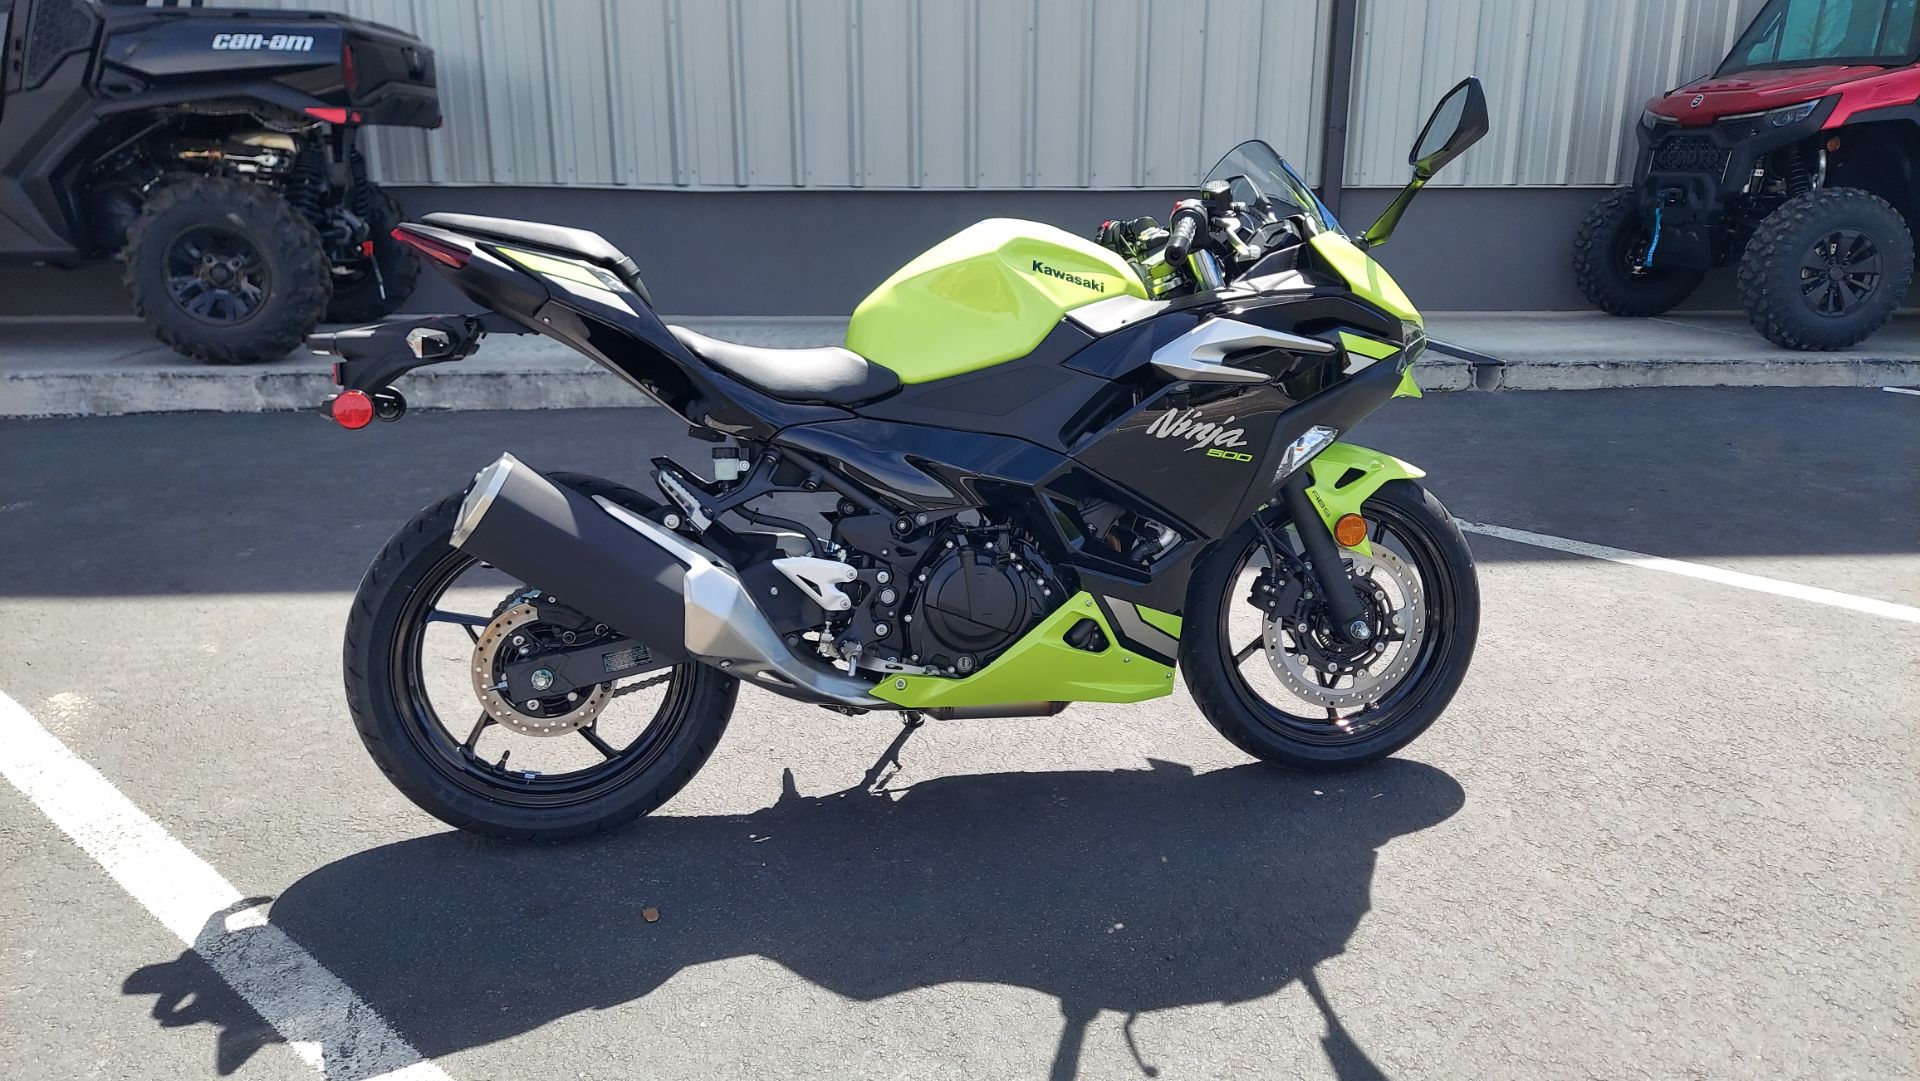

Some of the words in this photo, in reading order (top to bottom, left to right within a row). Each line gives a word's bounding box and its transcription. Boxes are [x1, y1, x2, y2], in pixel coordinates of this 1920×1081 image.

[212, 34, 314, 51] can-am
[1032, 260, 1105, 293] Kawasaki
[1146, 407, 1247, 452] Ninja
[1206, 448, 1253, 462] 500
